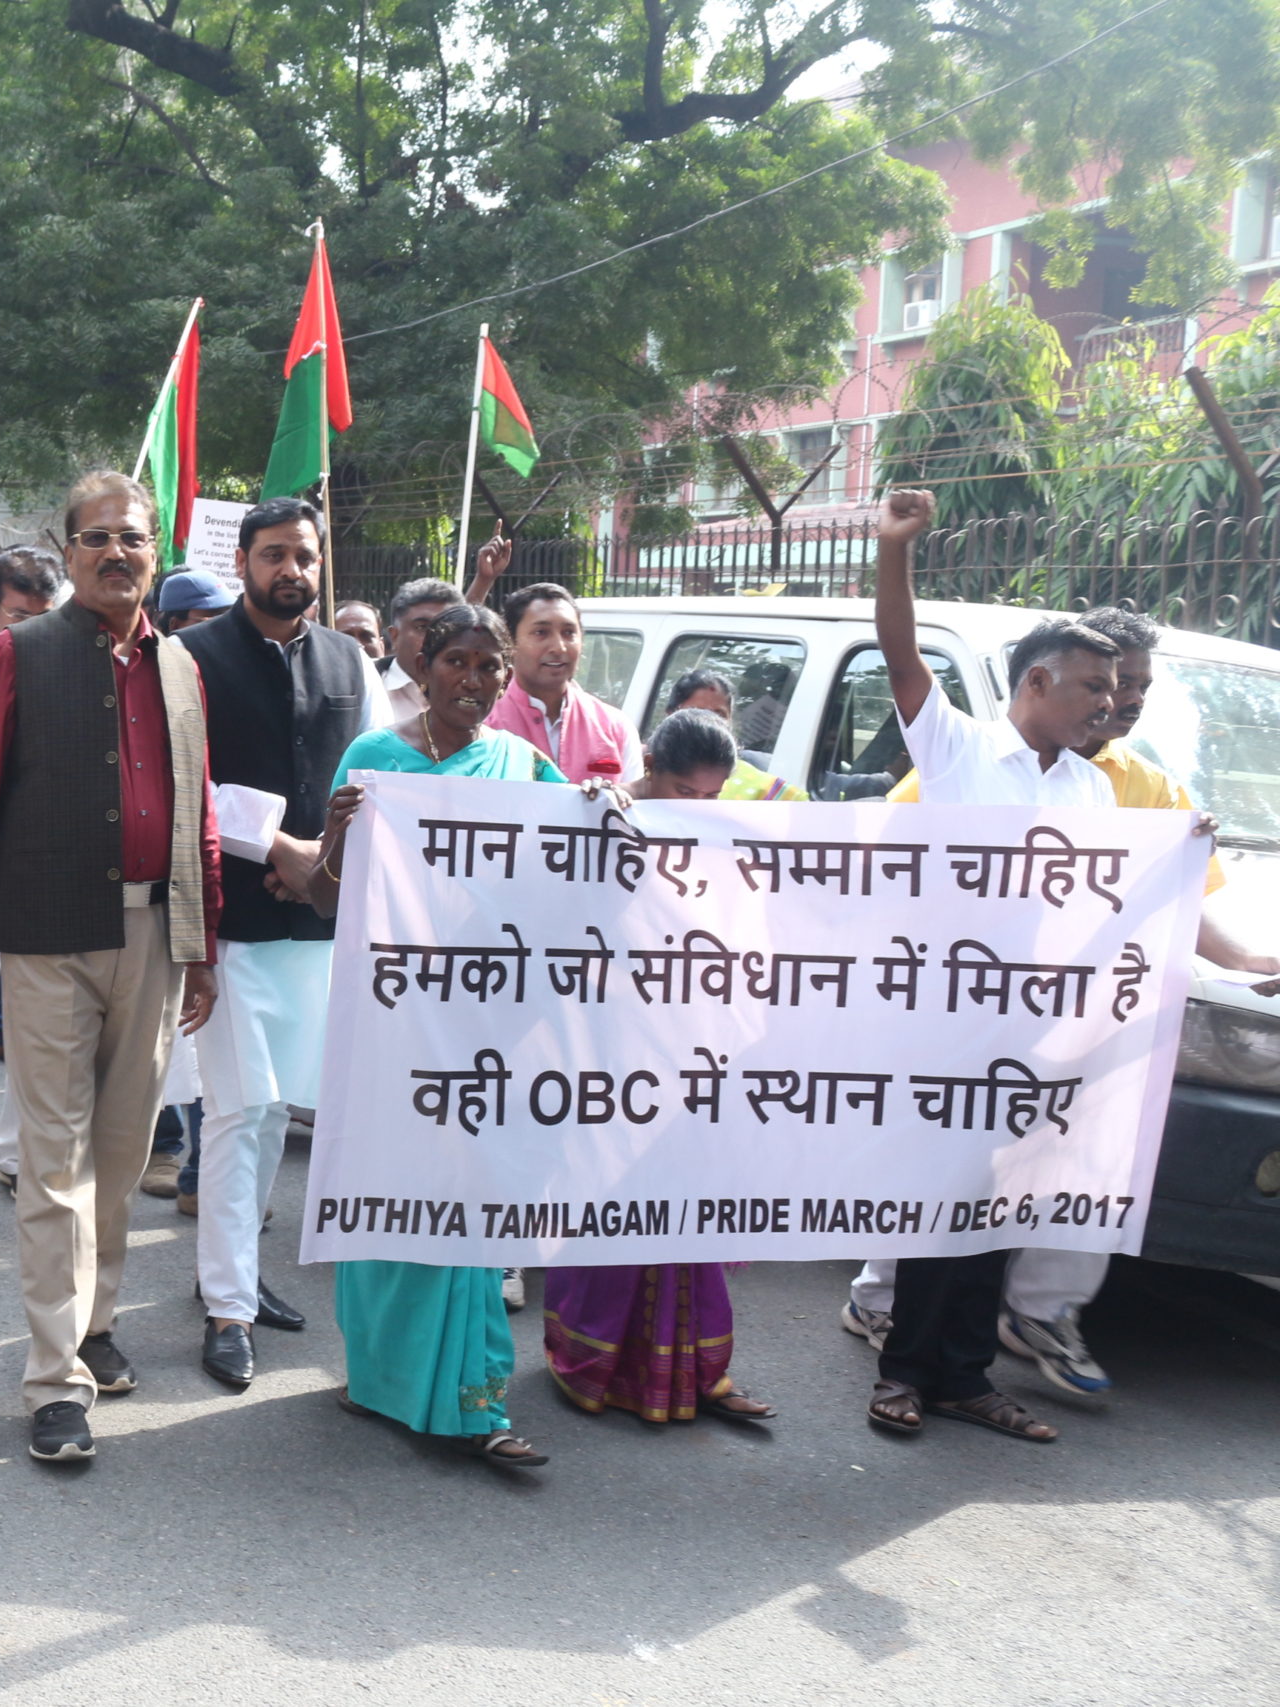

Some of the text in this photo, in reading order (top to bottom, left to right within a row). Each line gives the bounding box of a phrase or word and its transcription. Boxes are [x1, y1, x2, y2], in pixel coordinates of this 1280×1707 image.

[419, 808, 1129, 914] मान चाहिए, सम्मान चाहिए
[370, 923, 1151, 1023] हमको जो संविधान में मिला है
[411, 1047, 1083, 1139] वही OBC में स्थान चाहिए
[316, 1197, 467, 1237] PUTHIYA
[481, 1200, 669, 1239] TAMILAGAM
[696, 1198, 790, 1234] PRIDE
[801, 1199, 921, 1234] MARCH
[949, 1197, 1008, 1233] DEC
[1016, 1192, 1040, 1231] 6,
[1050, 1192, 1135, 1230] 2017
